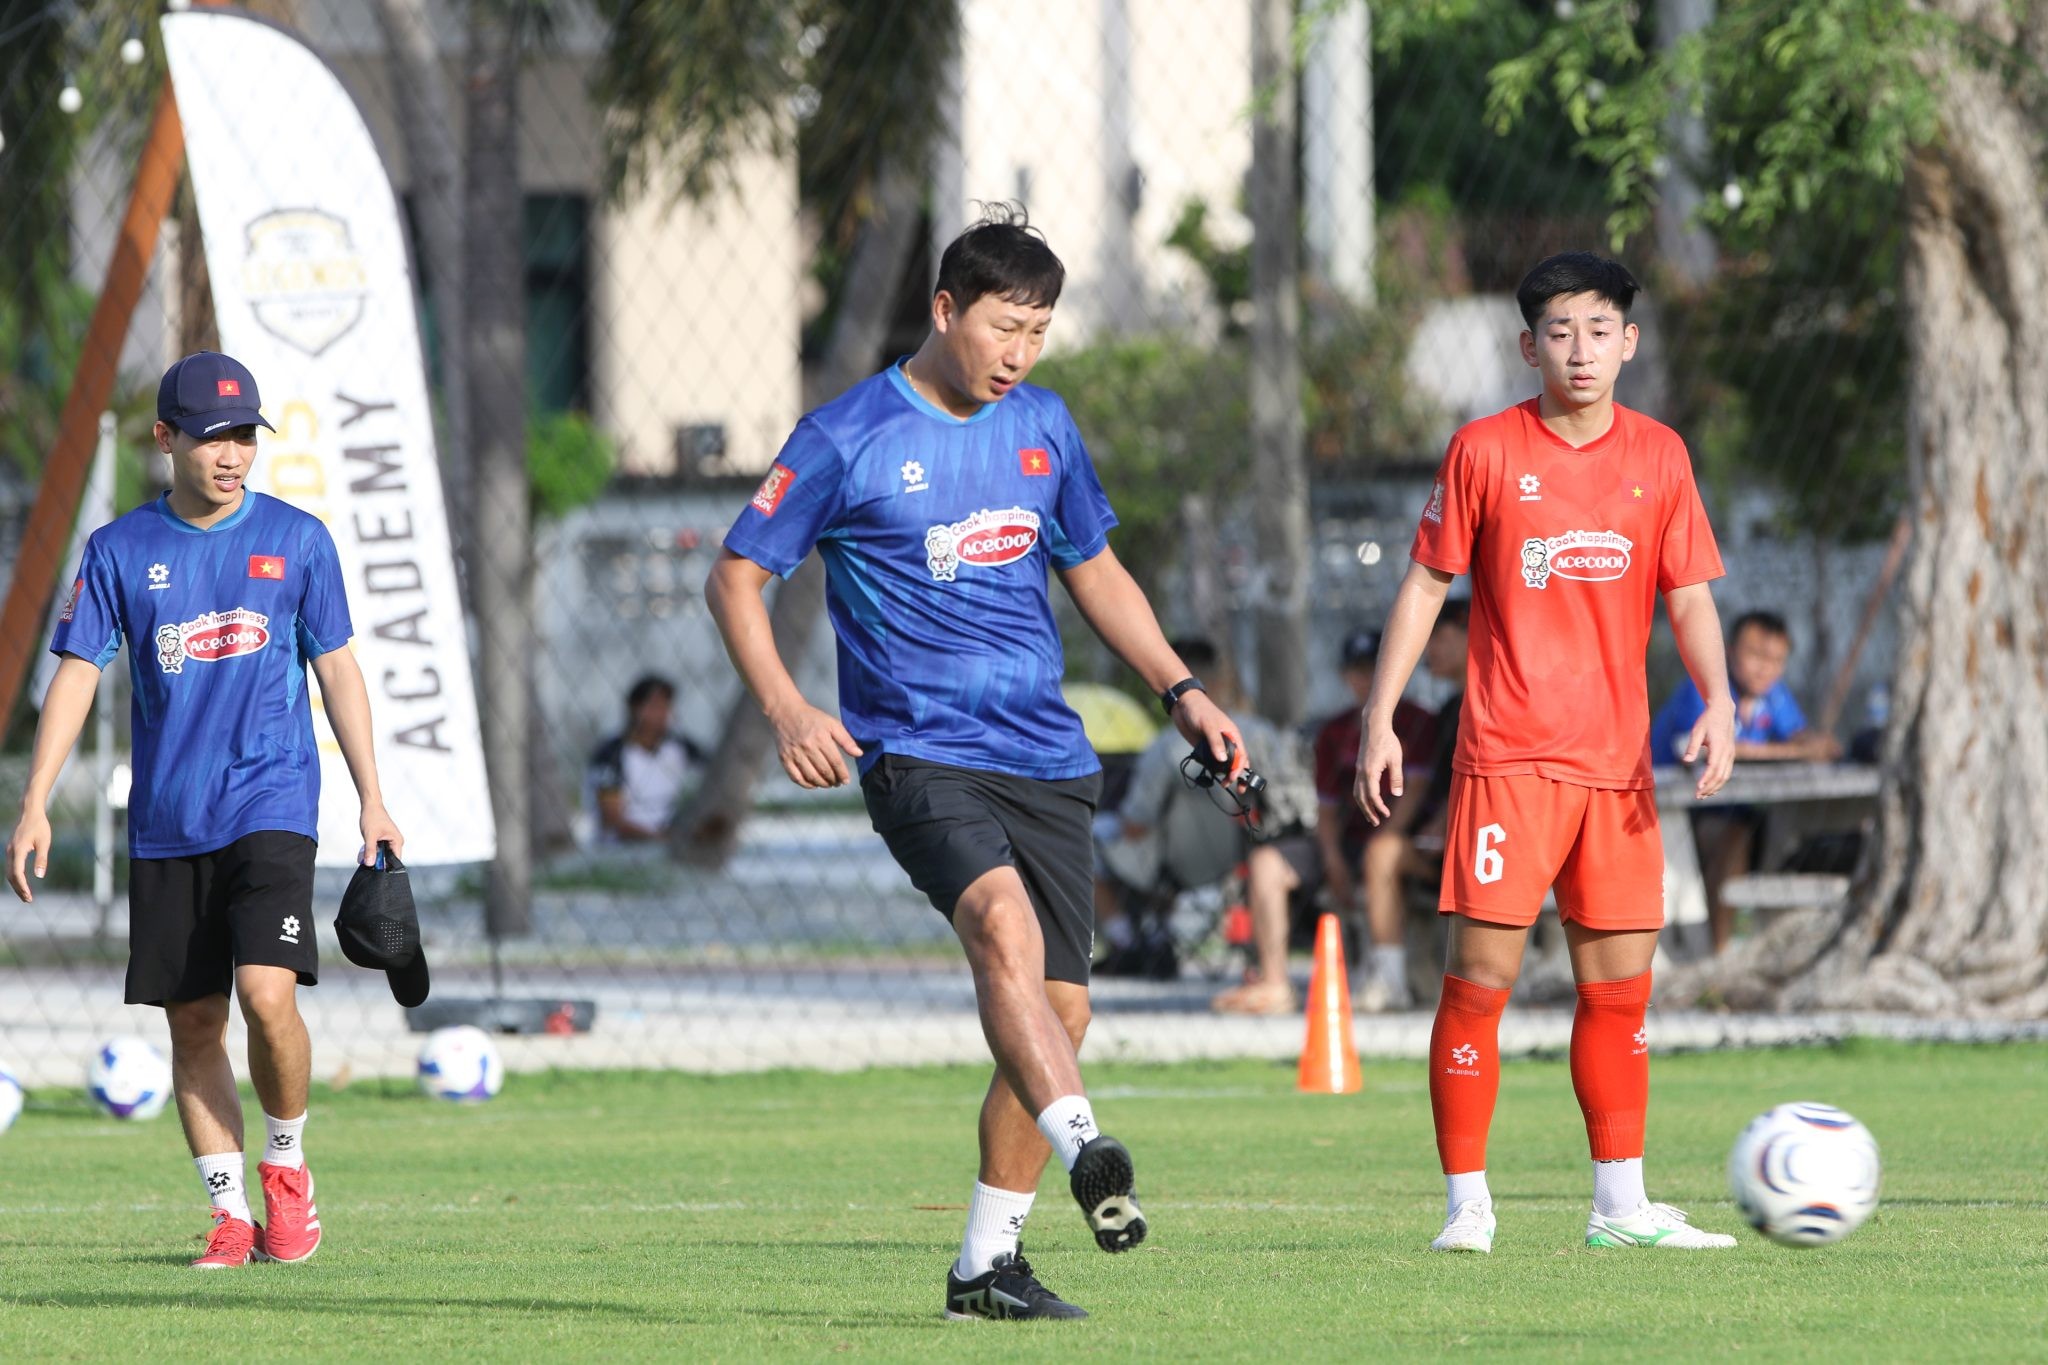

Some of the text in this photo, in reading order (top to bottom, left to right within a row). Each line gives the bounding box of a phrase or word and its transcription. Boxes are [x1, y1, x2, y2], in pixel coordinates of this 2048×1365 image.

[952, 508, 1038, 536] Cook happiness
[1548, 531, 1631, 550] Cook happiness
[334, 391, 453, 753] ACADEMY
[181, 609, 266, 635] Cook happiness
[1474, 822, 1507, 885] 6
